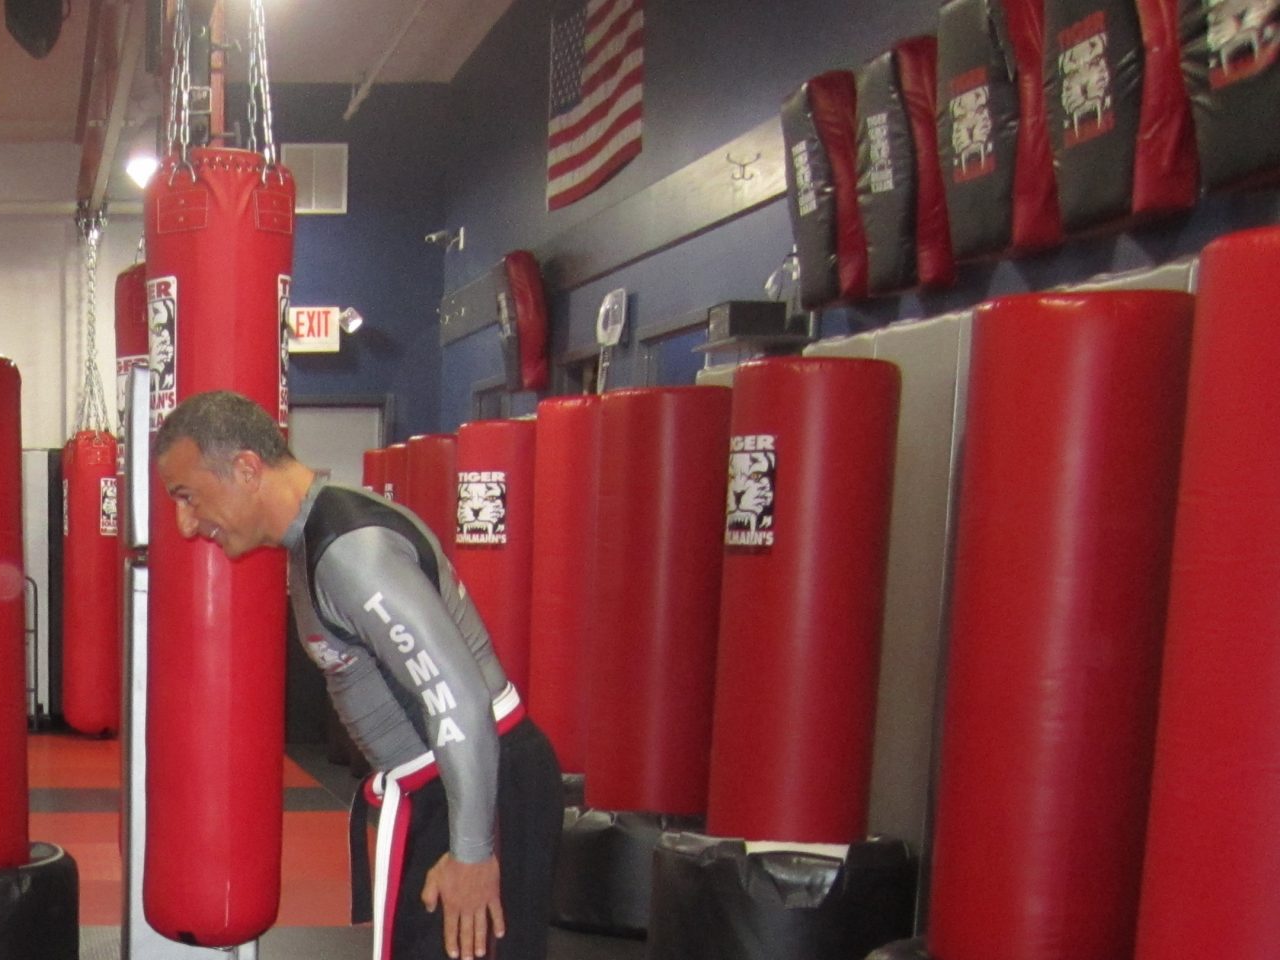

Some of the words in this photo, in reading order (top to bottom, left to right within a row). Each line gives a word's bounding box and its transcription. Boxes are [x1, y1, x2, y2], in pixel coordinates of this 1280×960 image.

[295, 310, 332, 338] EXIT
[457, 471, 506, 482] TIGER
[363, 591, 466, 747] TSMMA
